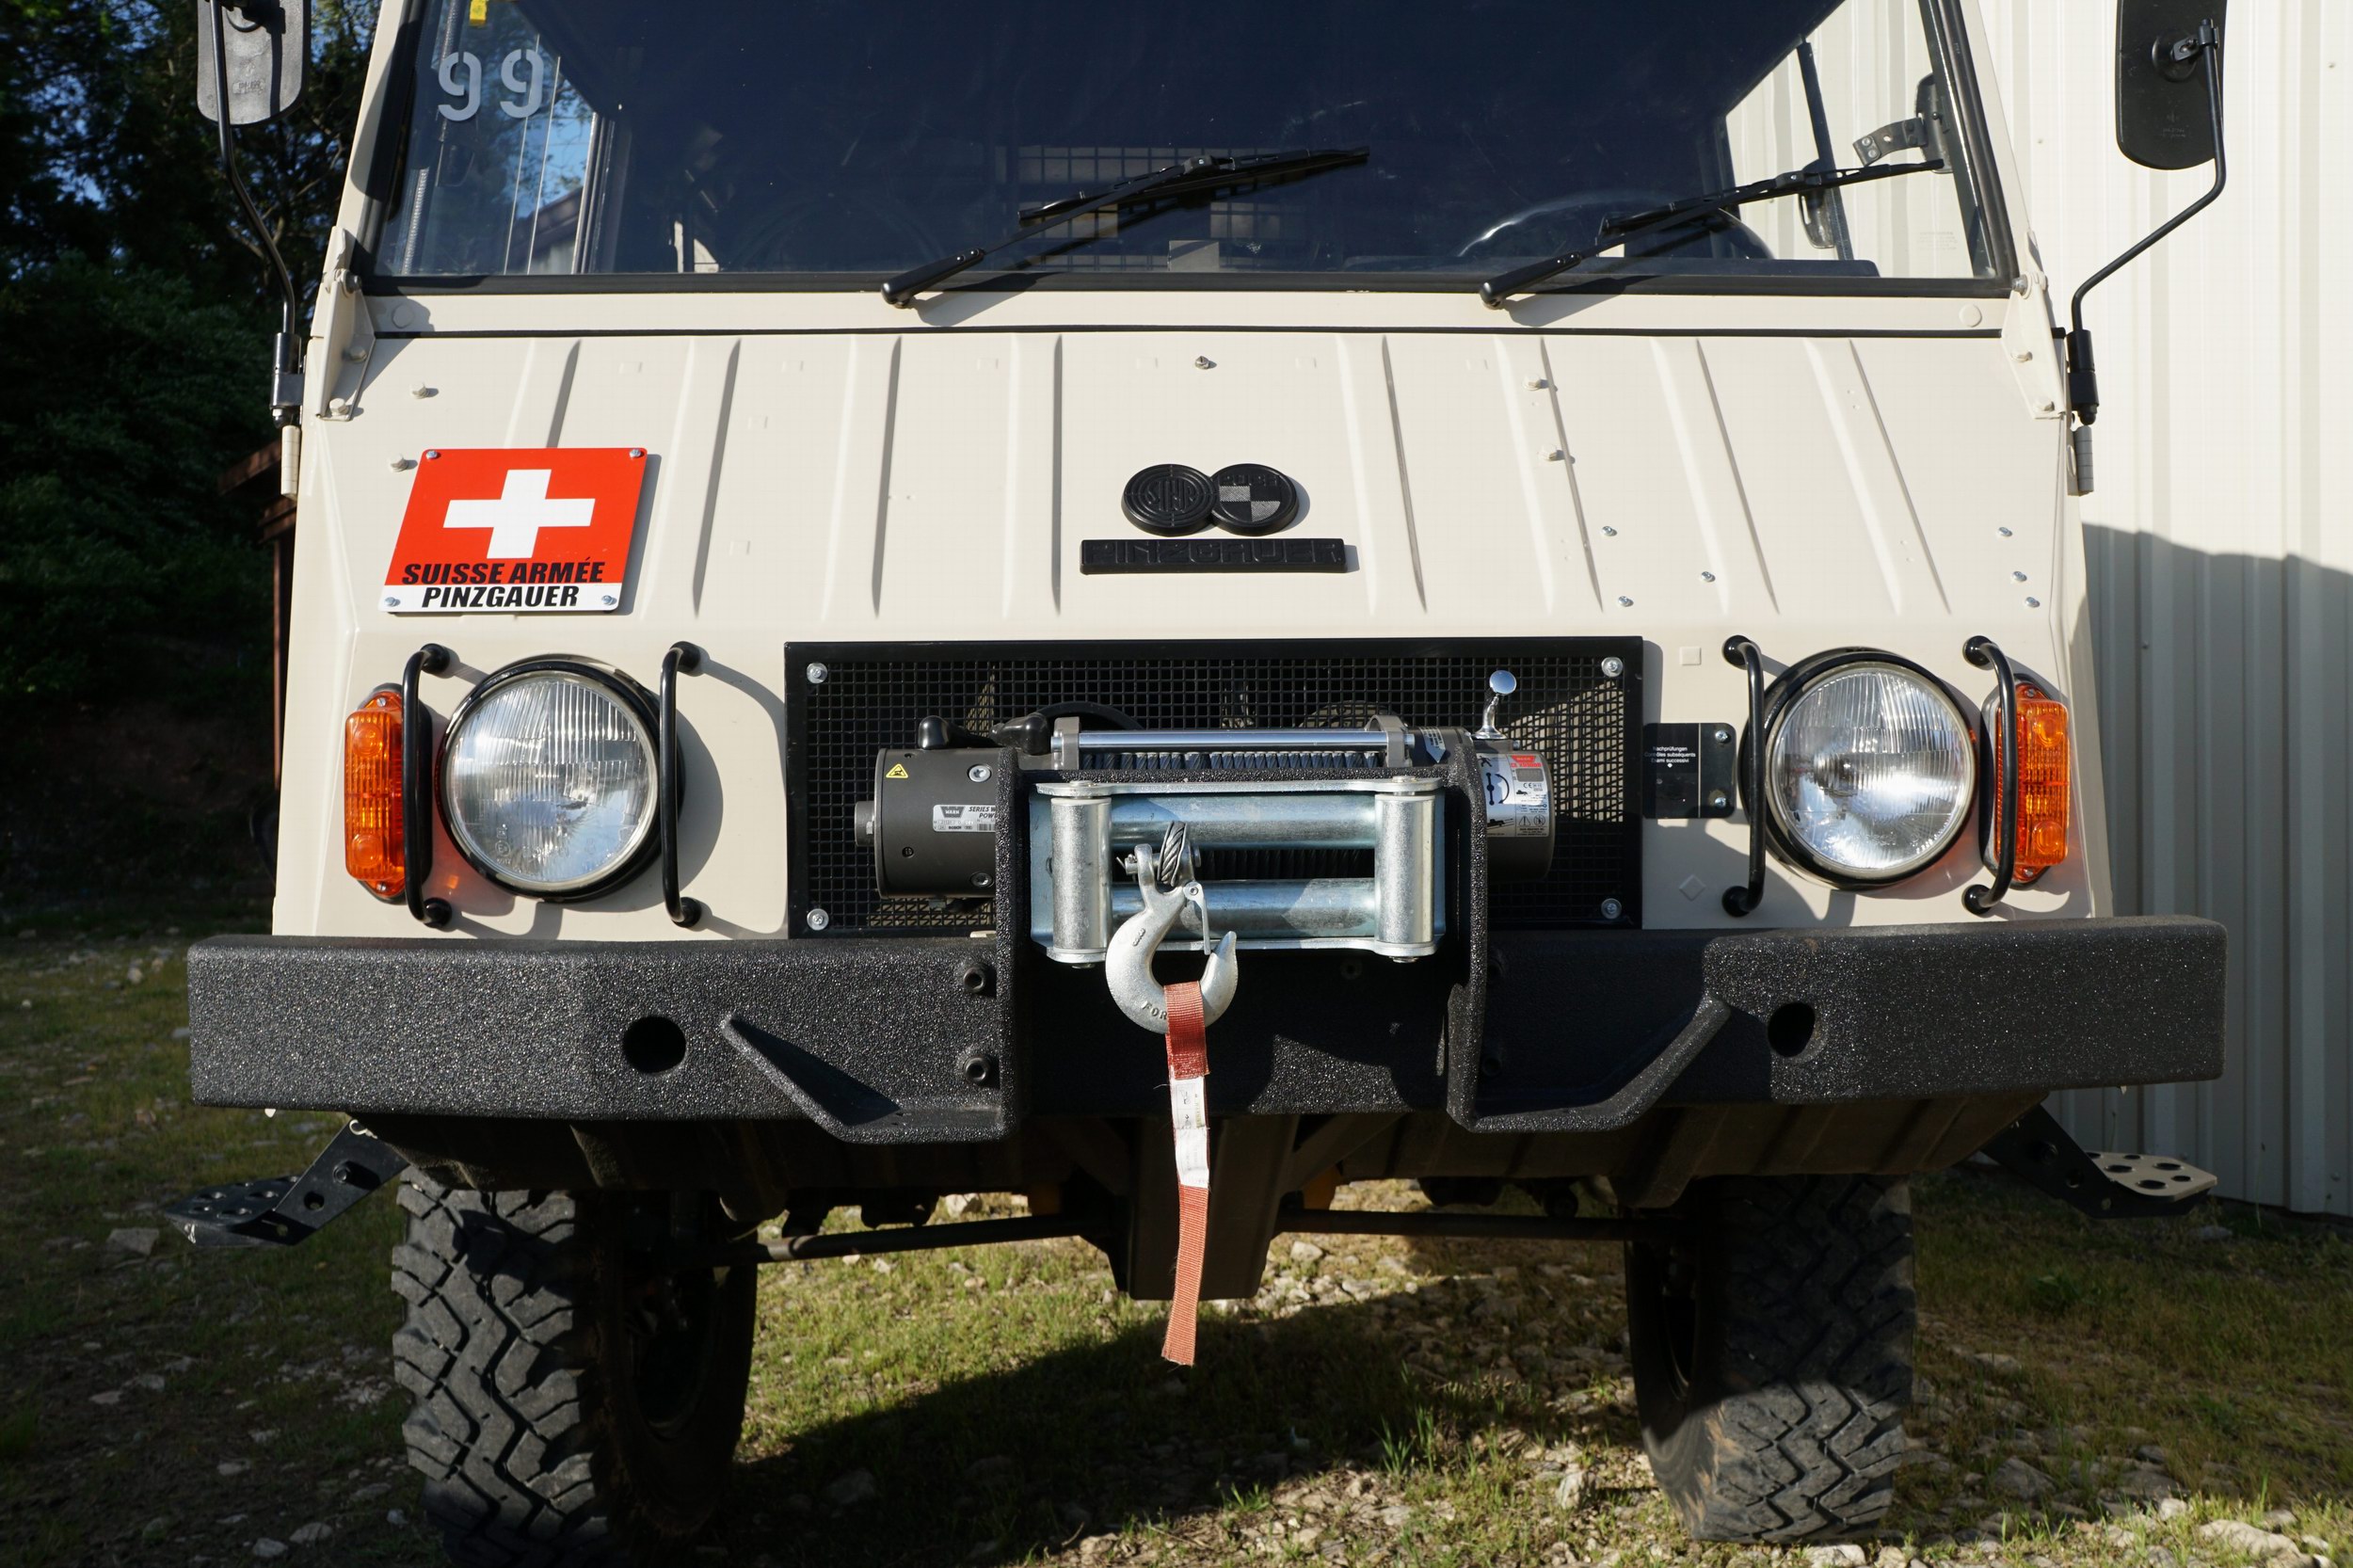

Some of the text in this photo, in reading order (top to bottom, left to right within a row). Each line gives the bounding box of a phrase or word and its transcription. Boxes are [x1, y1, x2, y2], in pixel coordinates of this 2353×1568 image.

[438, 48, 544, 121] 99
[1081, 539, 1342, 564] PINZGAUER
[402, 557, 606, 584] SUISSE ARMÉE
[422, 585, 580, 608] PINZGAUER
[1142, 1000, 1167, 1020] FOR
